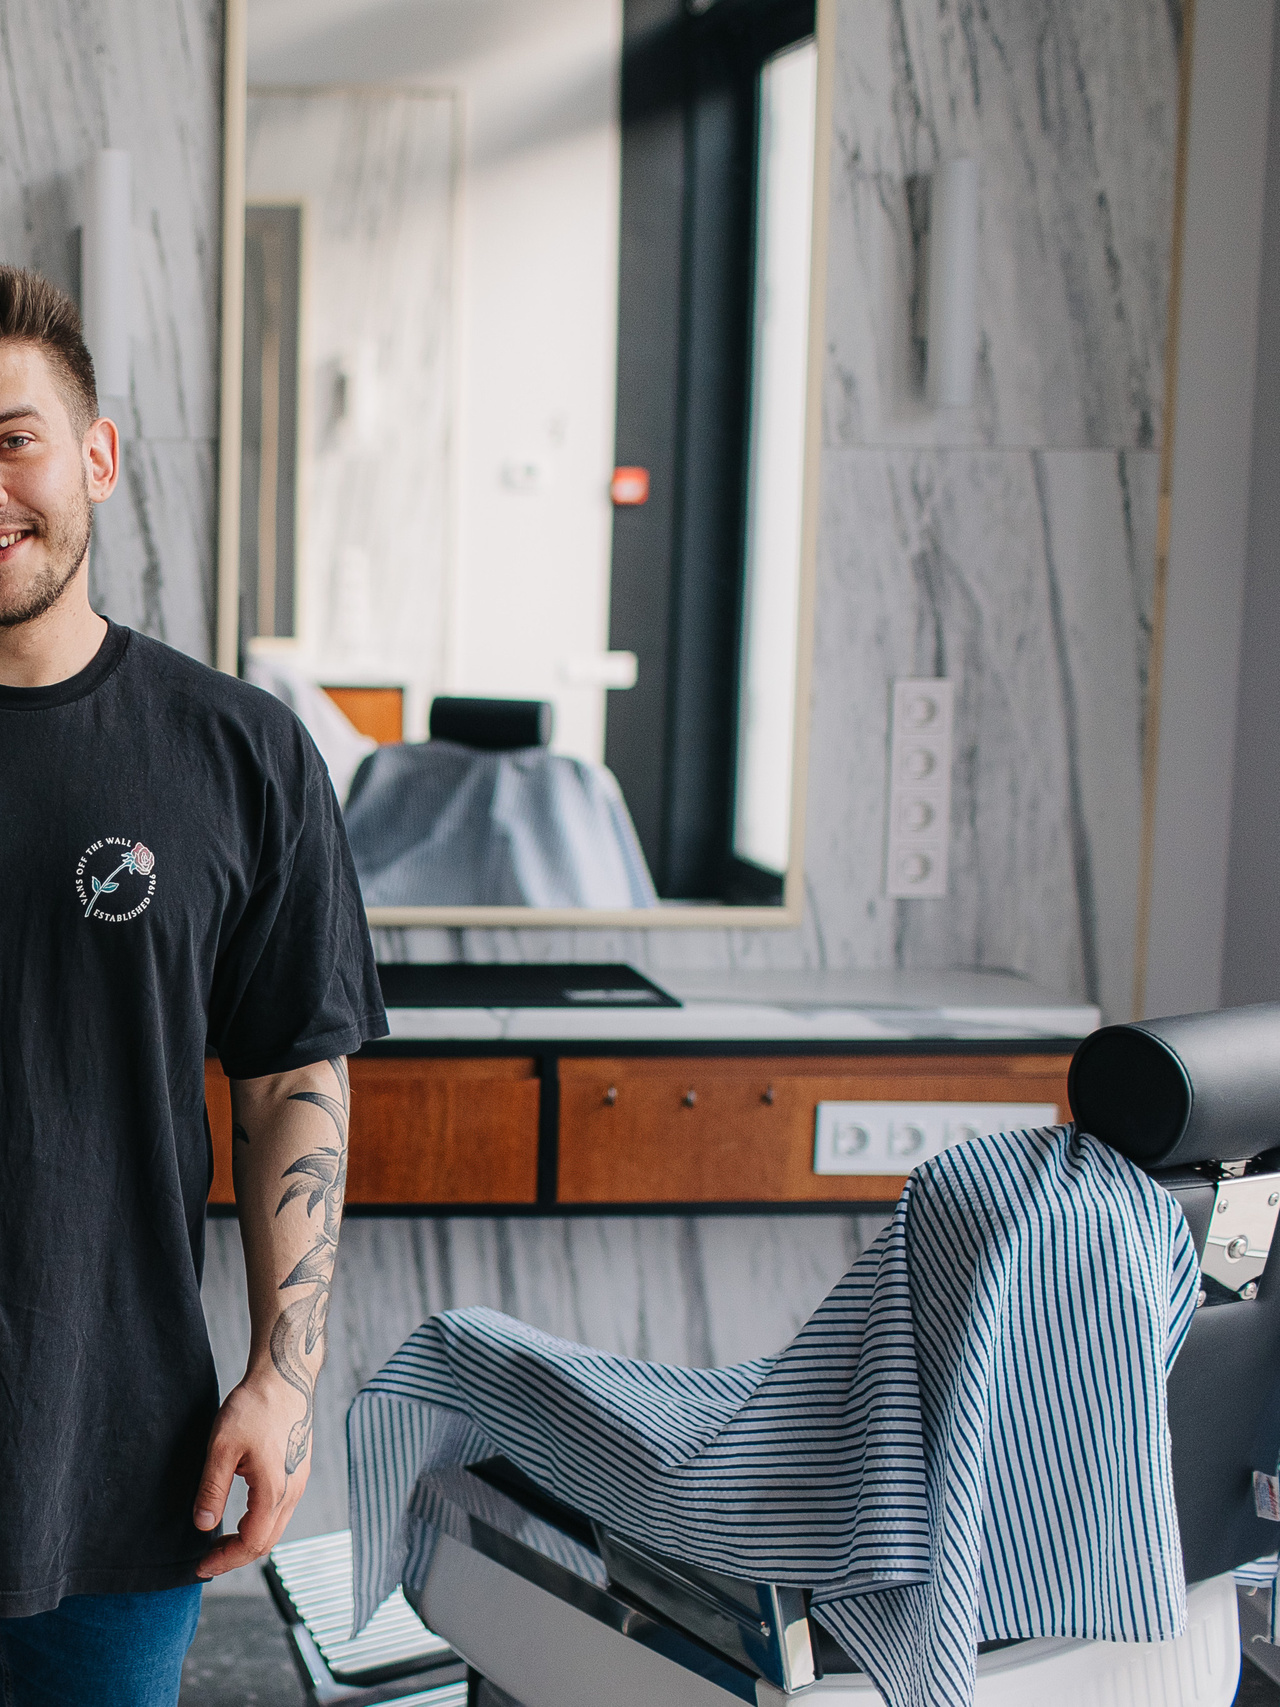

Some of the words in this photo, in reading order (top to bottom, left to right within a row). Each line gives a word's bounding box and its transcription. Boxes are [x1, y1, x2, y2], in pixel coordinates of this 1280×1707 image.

[85, 840, 104, 856] THE
[105, 837, 131, 848] WALL
[76, 856, 88, 875] OFF
[75, 879, 89, 905] VANS
[93, 897, 151, 922] ESTABLISHED
[147, 873, 156, 896] 1966
